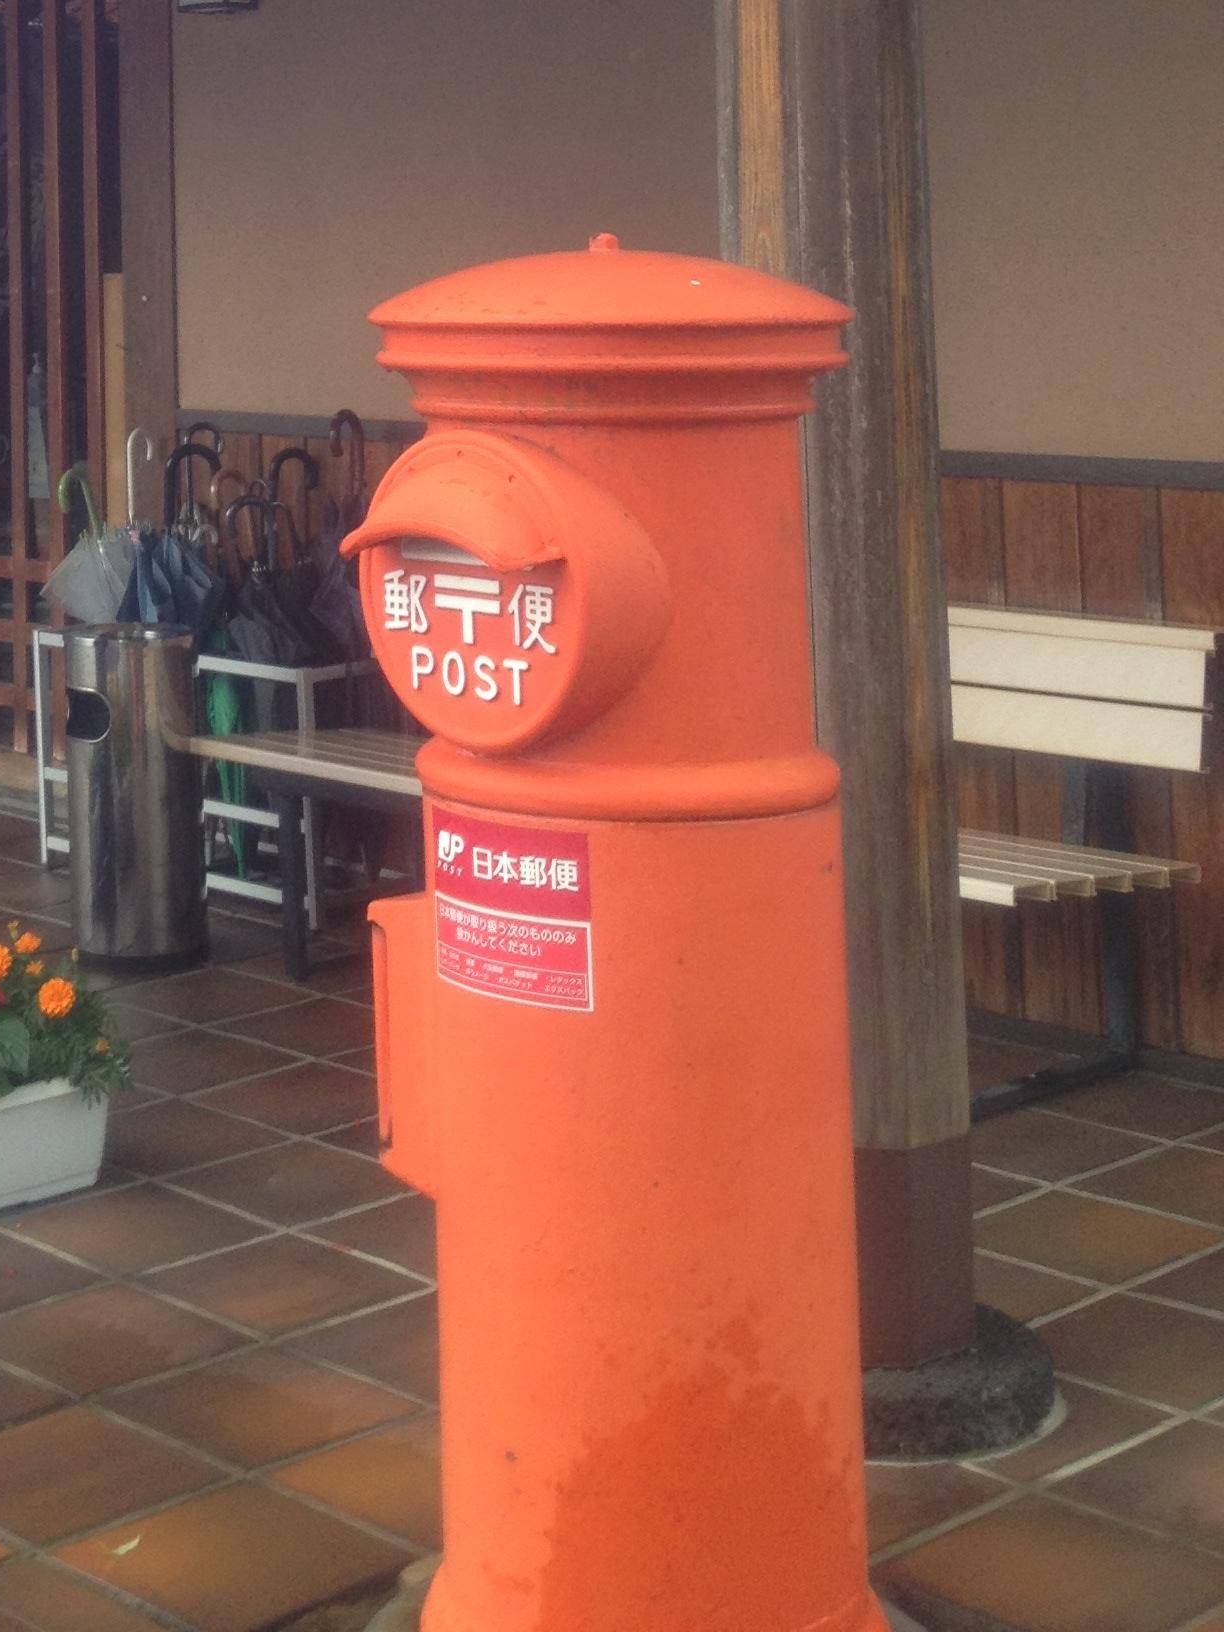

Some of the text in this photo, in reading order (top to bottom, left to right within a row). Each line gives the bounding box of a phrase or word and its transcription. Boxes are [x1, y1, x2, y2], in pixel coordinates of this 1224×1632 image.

[410, 645, 529, 706] POST
[472, 846, 579, 892] 日本郵便
